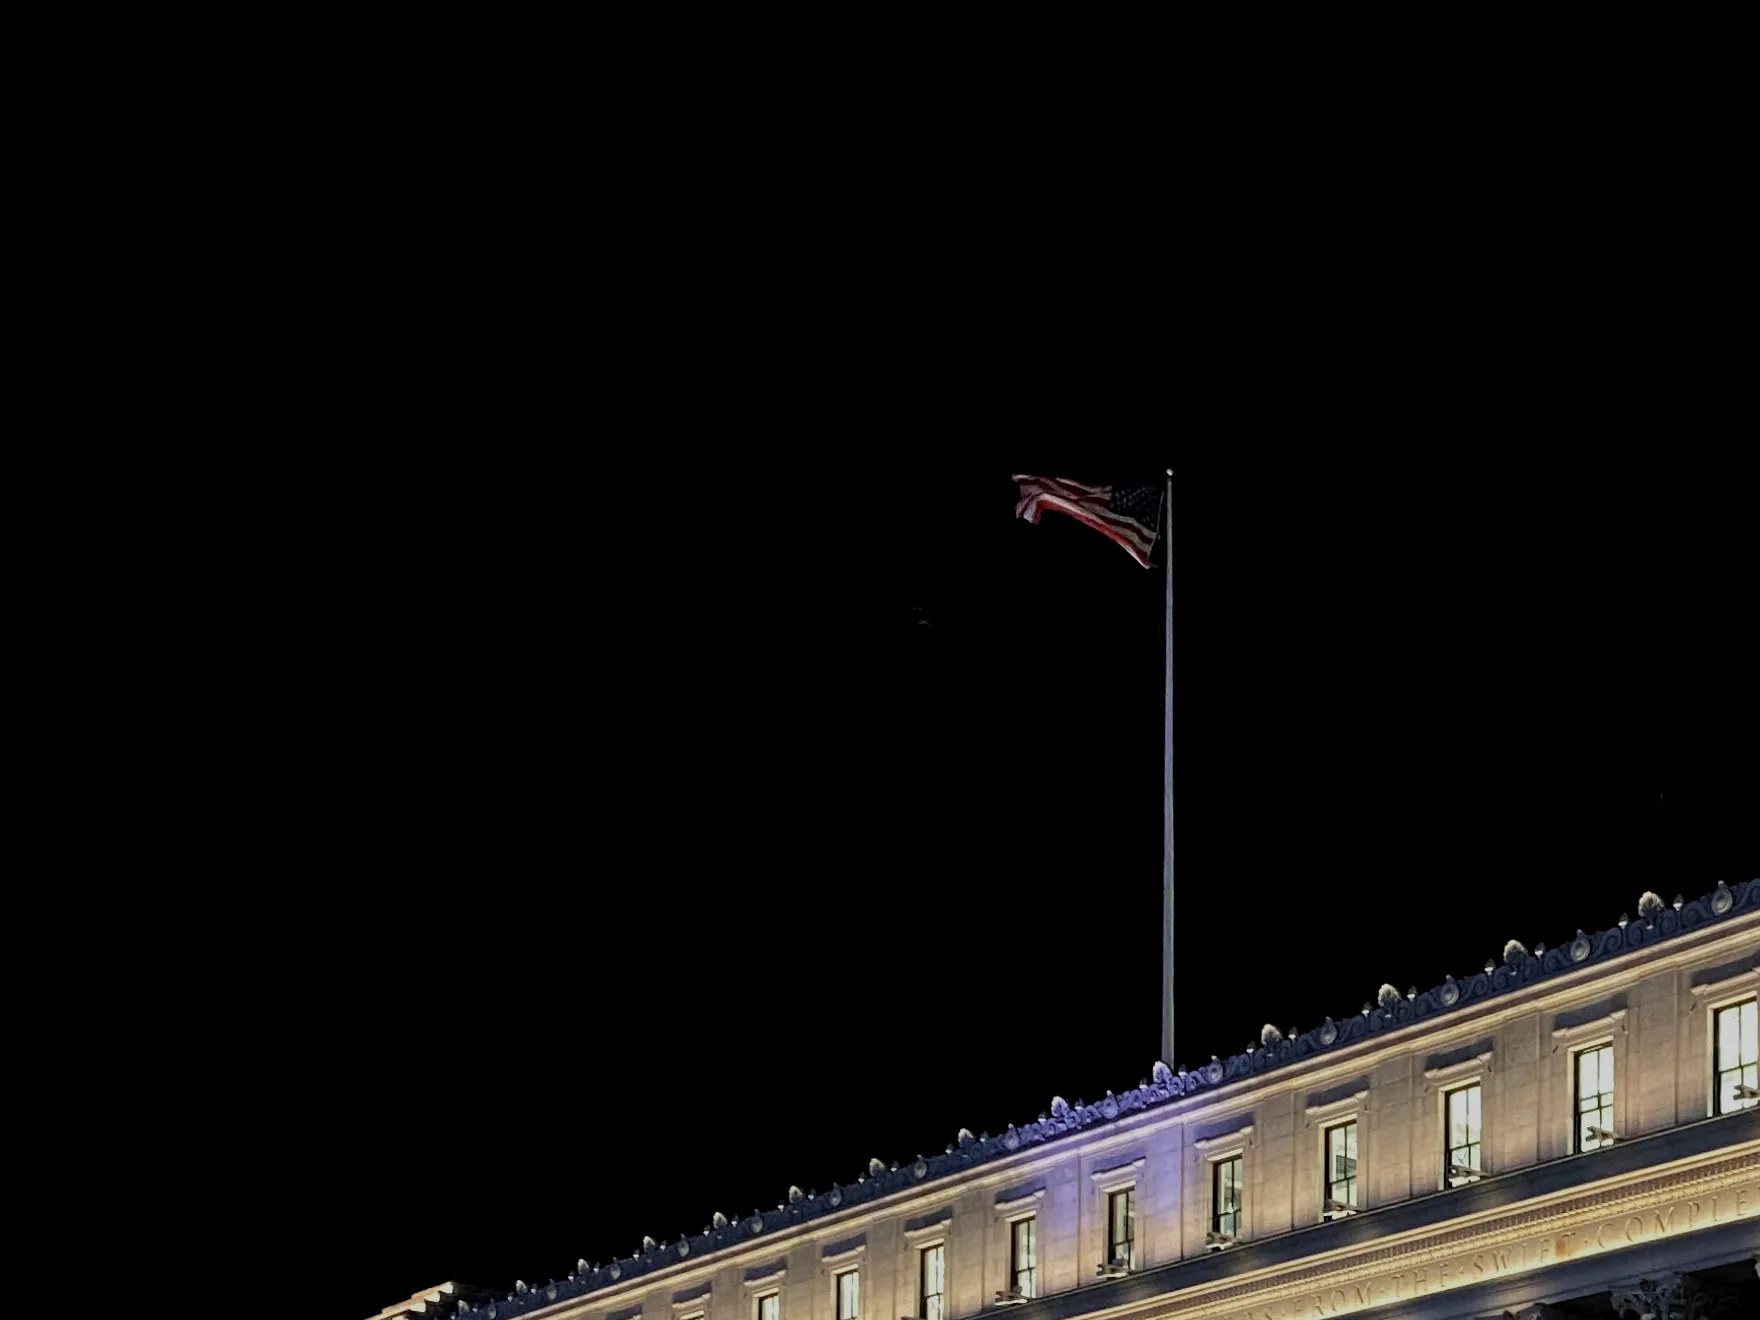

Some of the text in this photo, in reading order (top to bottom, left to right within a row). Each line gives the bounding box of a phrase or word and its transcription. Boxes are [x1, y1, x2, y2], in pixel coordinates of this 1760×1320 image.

[1292, 1279, 1374, 1320] FROM
[1394, 1261, 1452, 1292] THE
[1472, 1231, 1578, 1274] SWIFT
